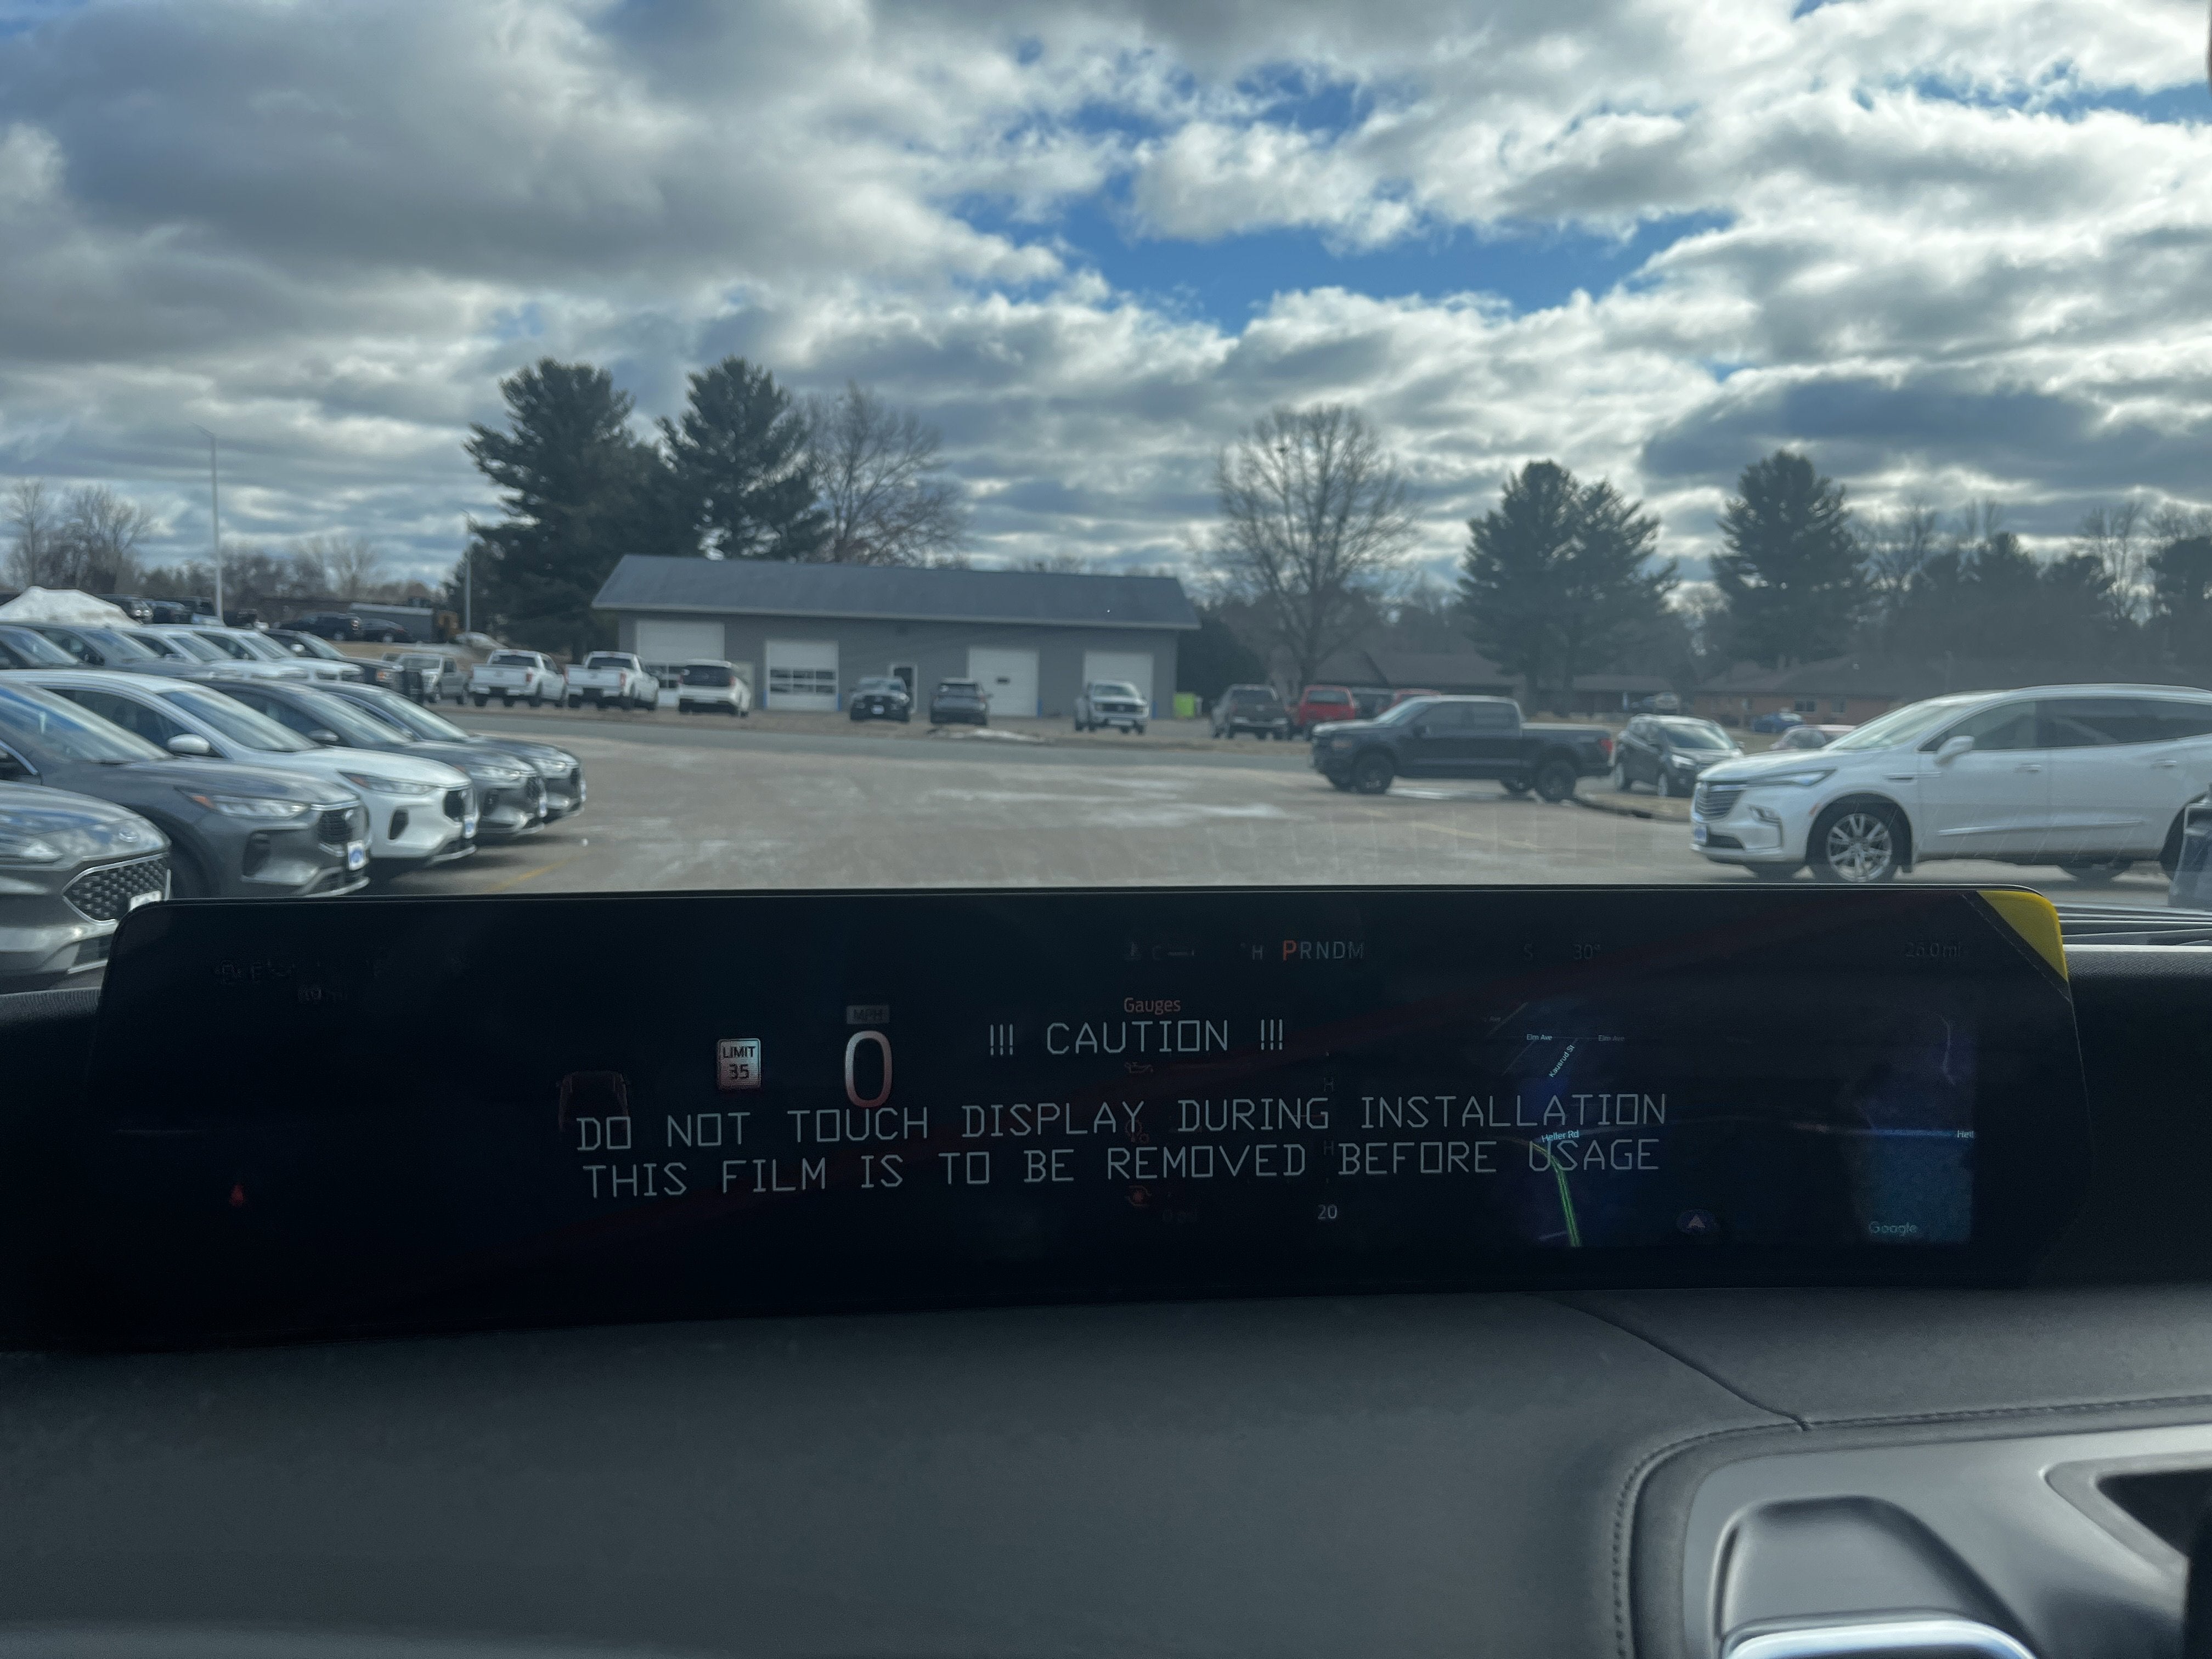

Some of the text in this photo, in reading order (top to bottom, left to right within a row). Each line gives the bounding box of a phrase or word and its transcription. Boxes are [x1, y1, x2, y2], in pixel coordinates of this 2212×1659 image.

[1124, 997, 1182, 1015] Gauges
[1047, 1020, 1227, 1054] CAUTION
[723, 1046, 756, 1059] LIMIT
[1566, 1044, 1576, 1053] St
[730, 1063, 750, 1080] 35
[844, 1030, 893, 1108] 0
[577, 1093, 1665, 1150] DO NOT TOUCH DISPLAY DURING INSTALLATION
[1567, 1130, 1580, 1138] Rd
[584, 1138, 1659, 1197] THIS FILM IS TO BE REMOVED BEFORE USAGE
[1318, 1204, 1338, 1220] 20
[1869, 1221, 1918, 1236] Google
